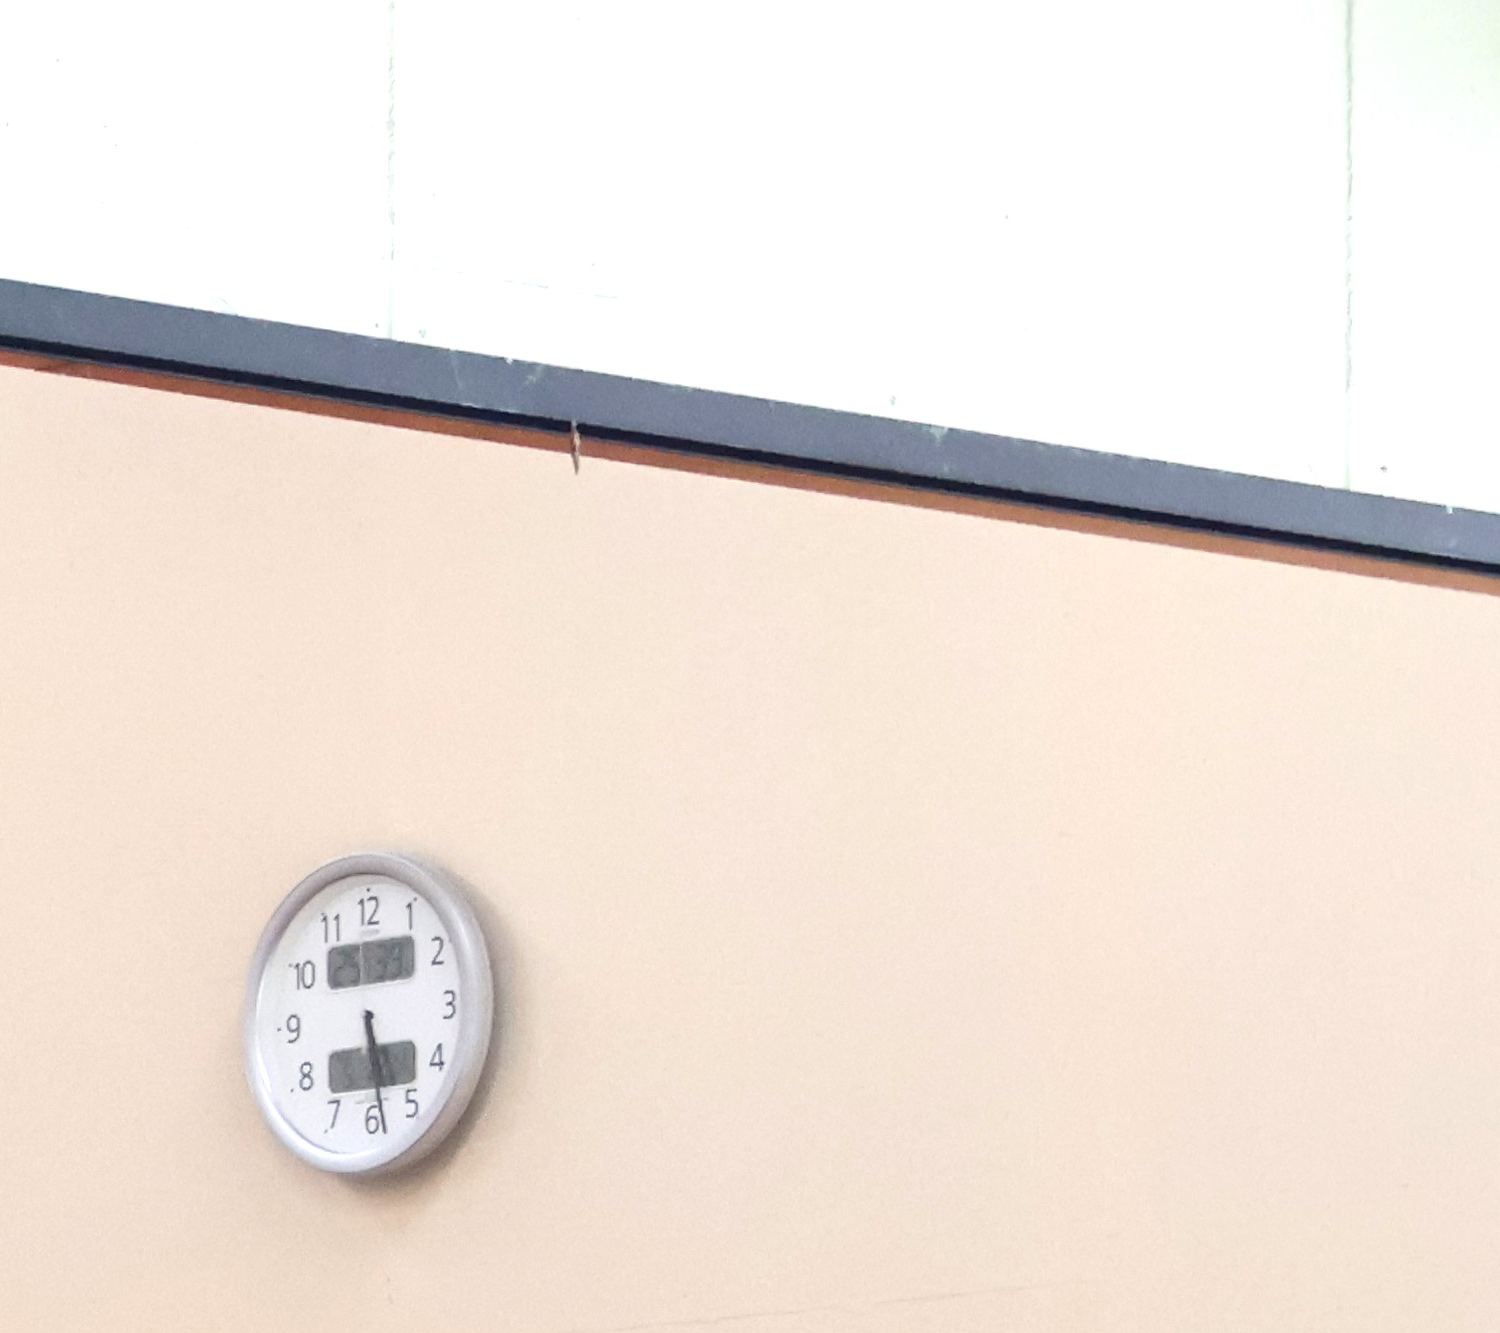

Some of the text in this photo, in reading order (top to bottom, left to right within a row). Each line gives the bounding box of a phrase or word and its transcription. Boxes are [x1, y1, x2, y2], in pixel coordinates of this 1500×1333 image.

[357, 896, 380, 926] 12
[405, 902, 414, 930] 1
[321, 913, 342, 943] 11
[431, 936, 444, 965] 2
[294, 960, 316, 991] 10
[443, 990, 456, 1020] 3
[286, 1014, 301, 1043] 9
[429, 1043, 445, 1071] 4
[299, 1061, 313, 1091] 8
[327, 1099, 342, 1129] 7
[365, 1103, 380, 1135] 6
[405, 1089, 419, 1119] 5
